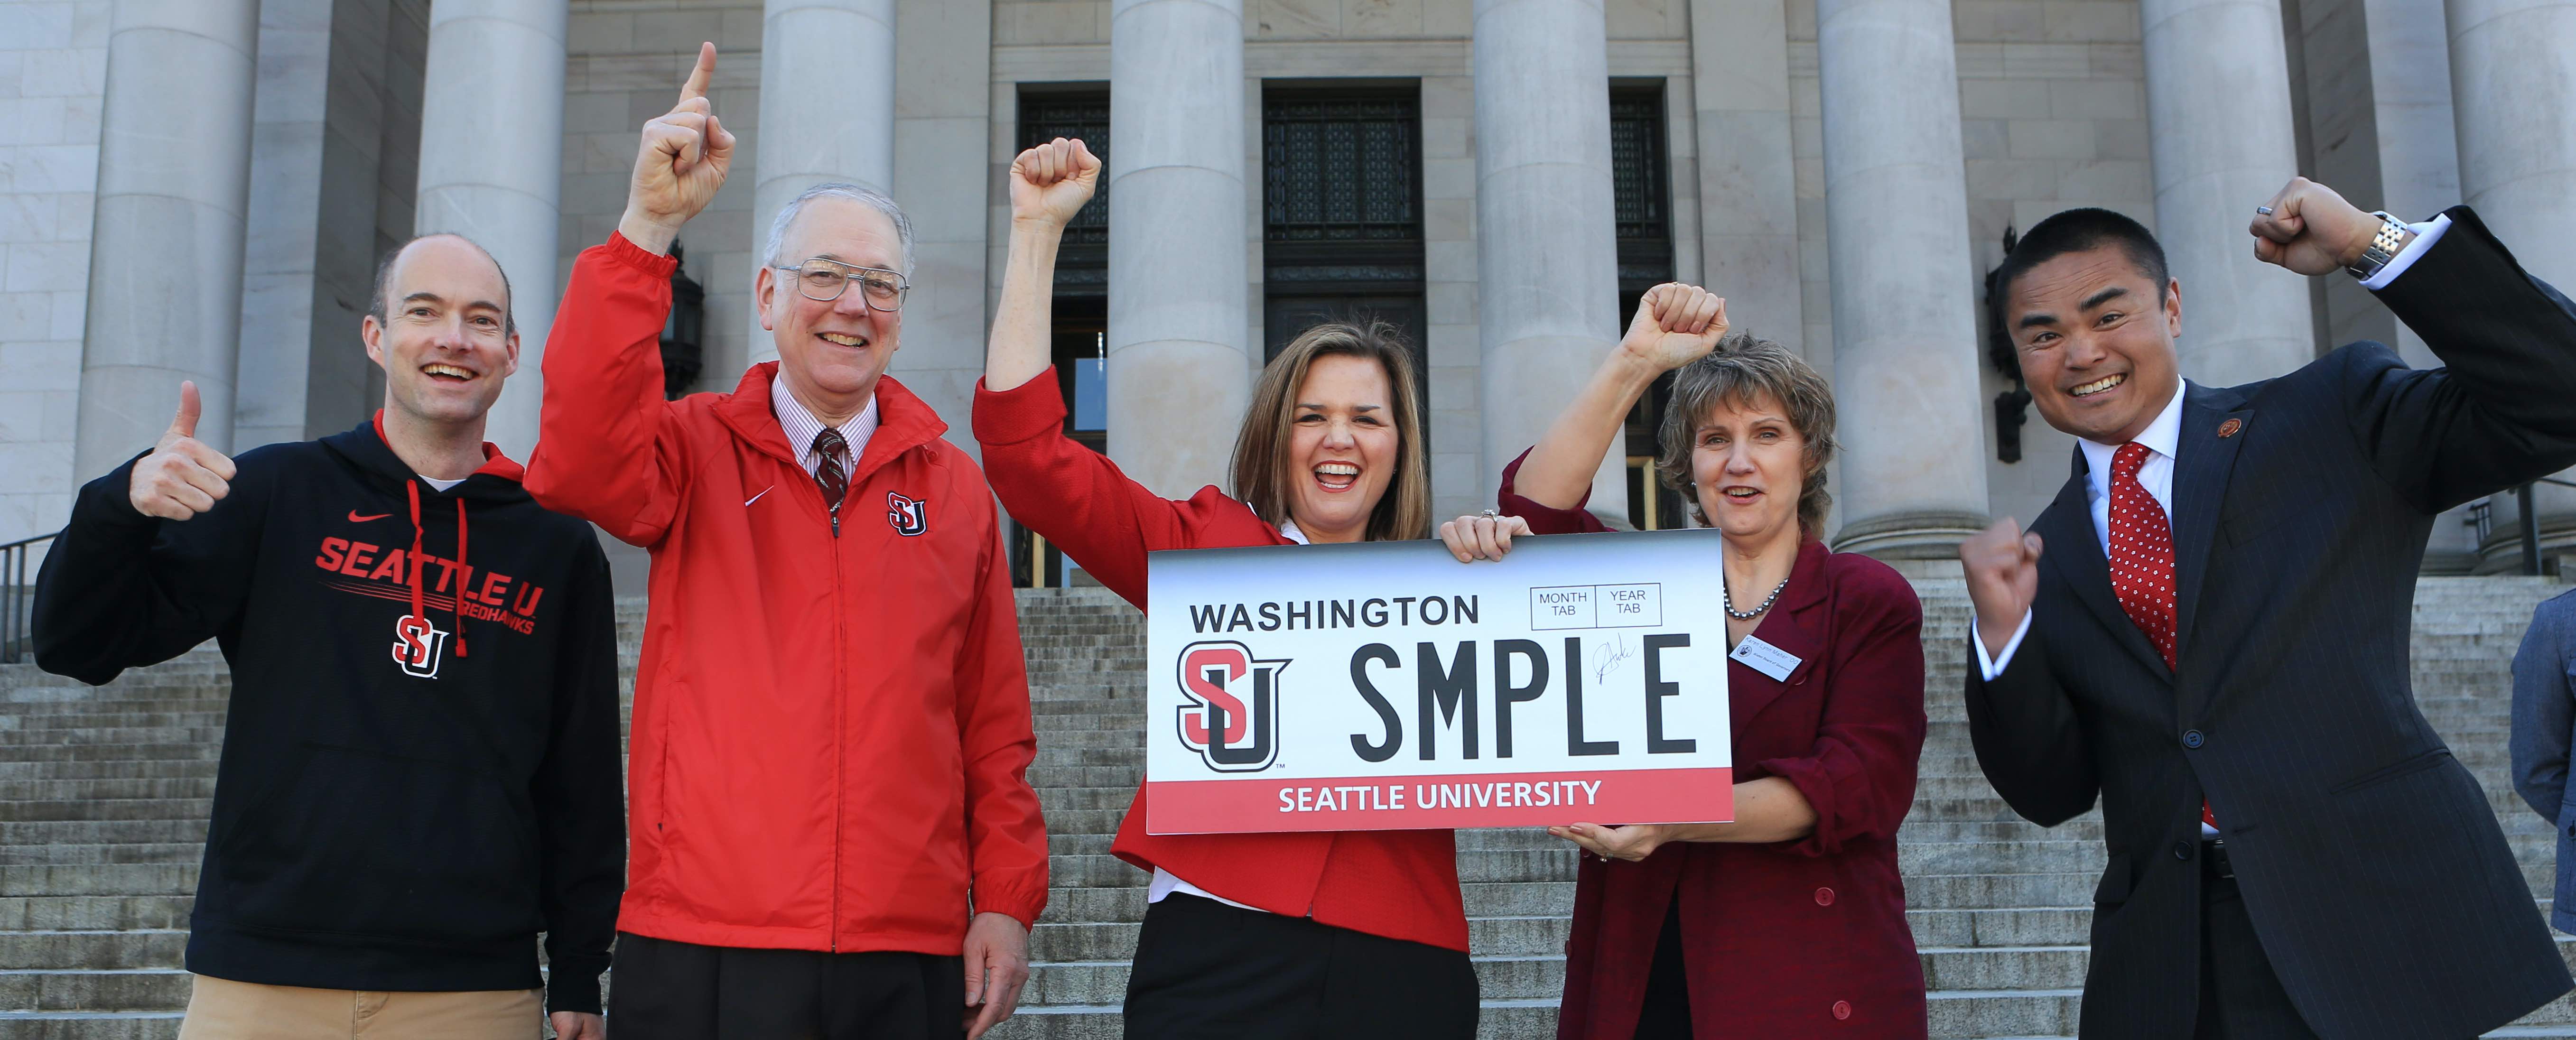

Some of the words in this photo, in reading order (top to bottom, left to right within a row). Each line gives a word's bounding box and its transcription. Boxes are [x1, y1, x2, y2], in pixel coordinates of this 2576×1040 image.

[888, 491, 927, 537] SU
[1540, 592, 1587, 604] MONTH
[1552, 605, 1576, 616] TAB
[1610, 590, 1646, 601] YEAR
[1616, 603, 1641, 613] TAB
[462, 601, 535, 635] REDHAWKS
[1190, 595, 1479, 633] WASHINGTON
[392, 615, 449, 678] SU
[1179, 642, 1281, 770] SU
[1350, 633, 1696, 762] SMPLE
[1279, 785, 1404, 813] SEATTLE
[1416, 780, 1602, 809] UNIVERSITY
